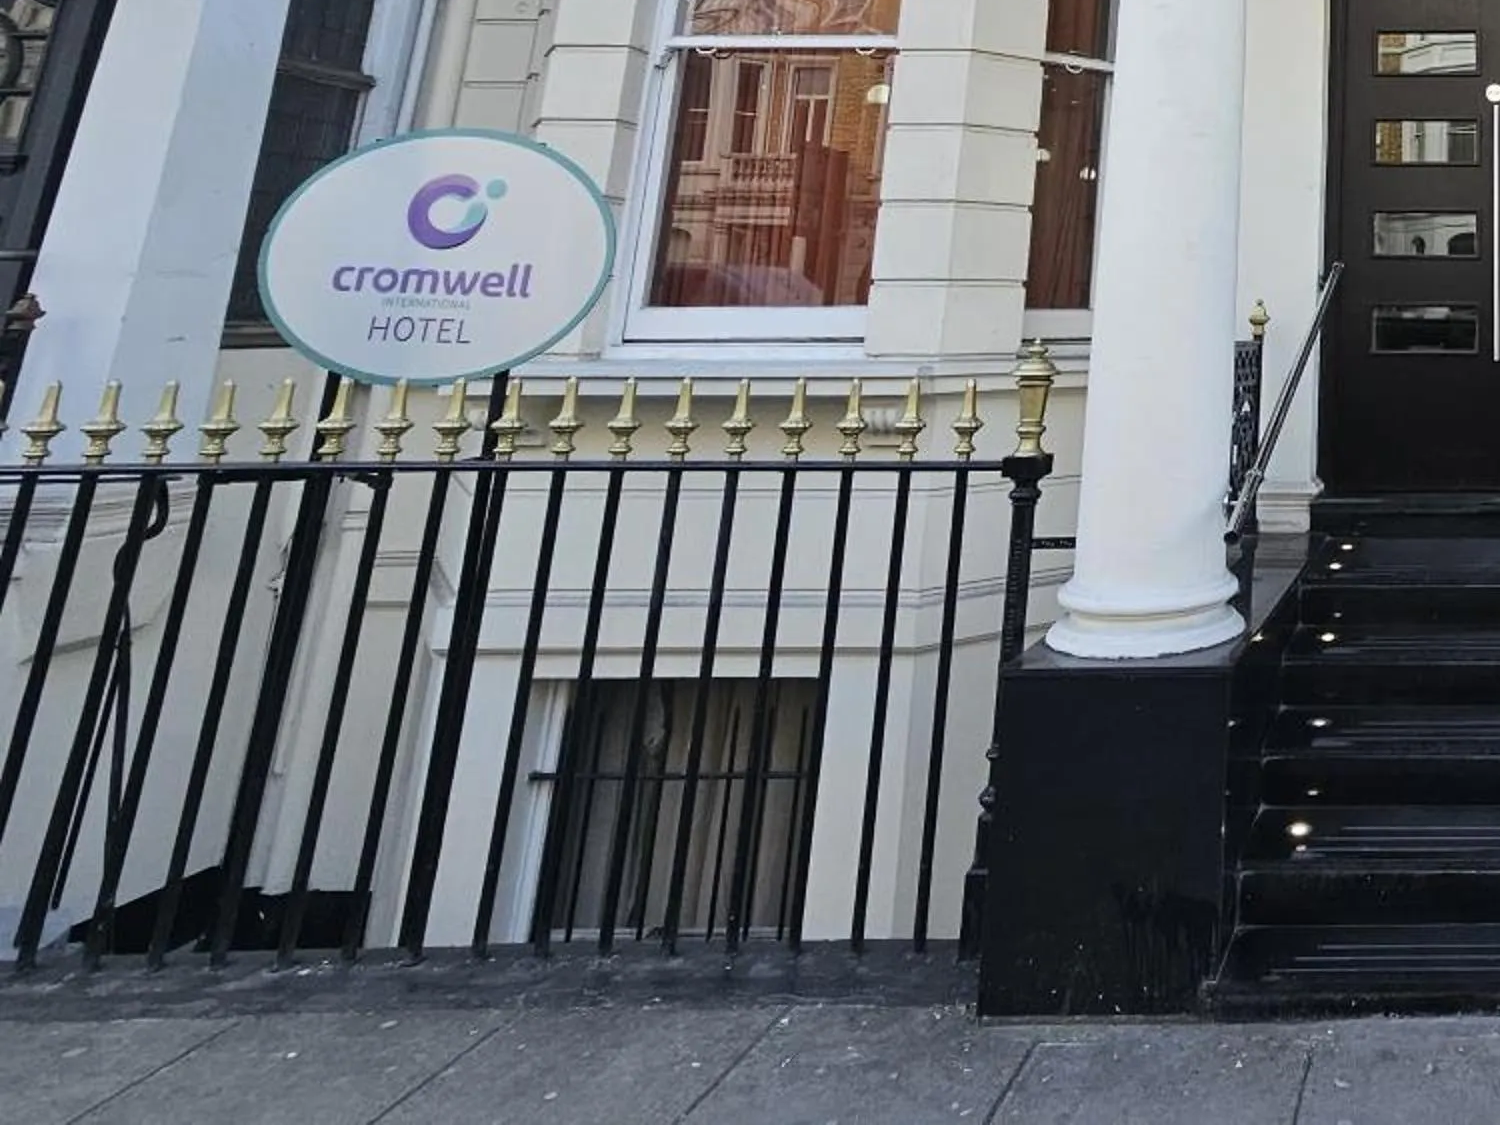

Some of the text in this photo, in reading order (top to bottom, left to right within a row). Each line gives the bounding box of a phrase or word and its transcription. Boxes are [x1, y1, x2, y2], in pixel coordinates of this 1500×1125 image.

[332, 263, 533, 298] cromwell
[381, 297, 471, 311] INTERNATIONAL
[367, 316, 471, 344] HOTEL
